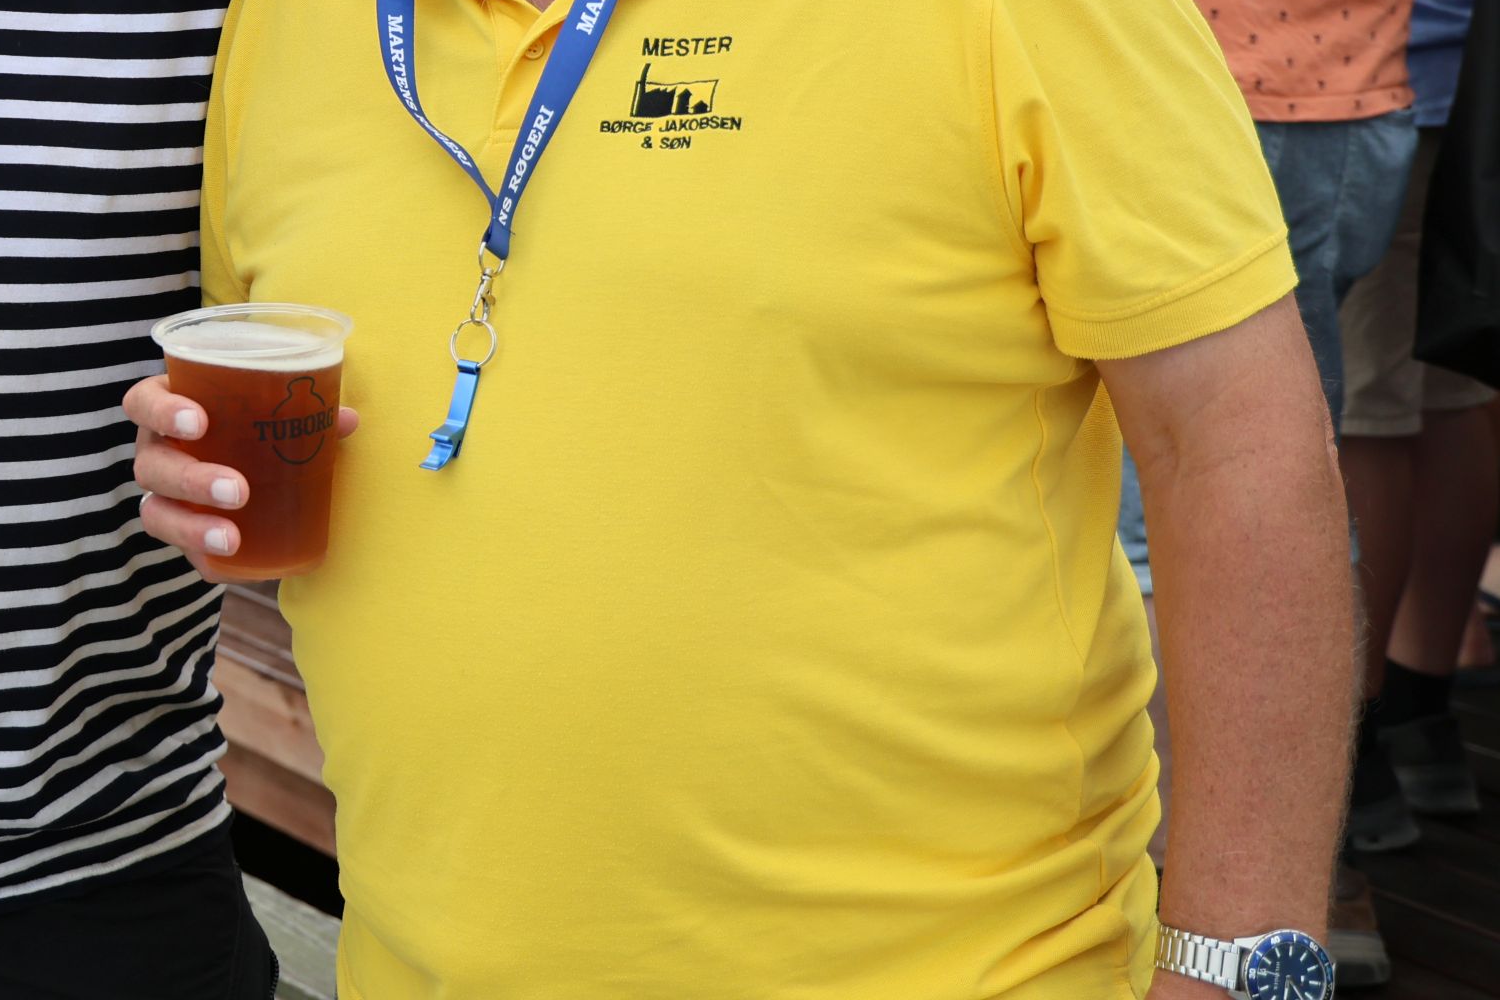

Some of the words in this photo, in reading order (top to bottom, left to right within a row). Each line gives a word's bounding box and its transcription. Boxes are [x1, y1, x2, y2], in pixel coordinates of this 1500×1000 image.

[642, 36, 733, 57] MESTER
[387, 14, 418, 112] MARTENS
[658, 116, 743, 132] JAKOBSEN
[508, 104, 555, 194] RØGERI
[641, 136, 653, 149] &
[659, 136, 692, 150] SØN
